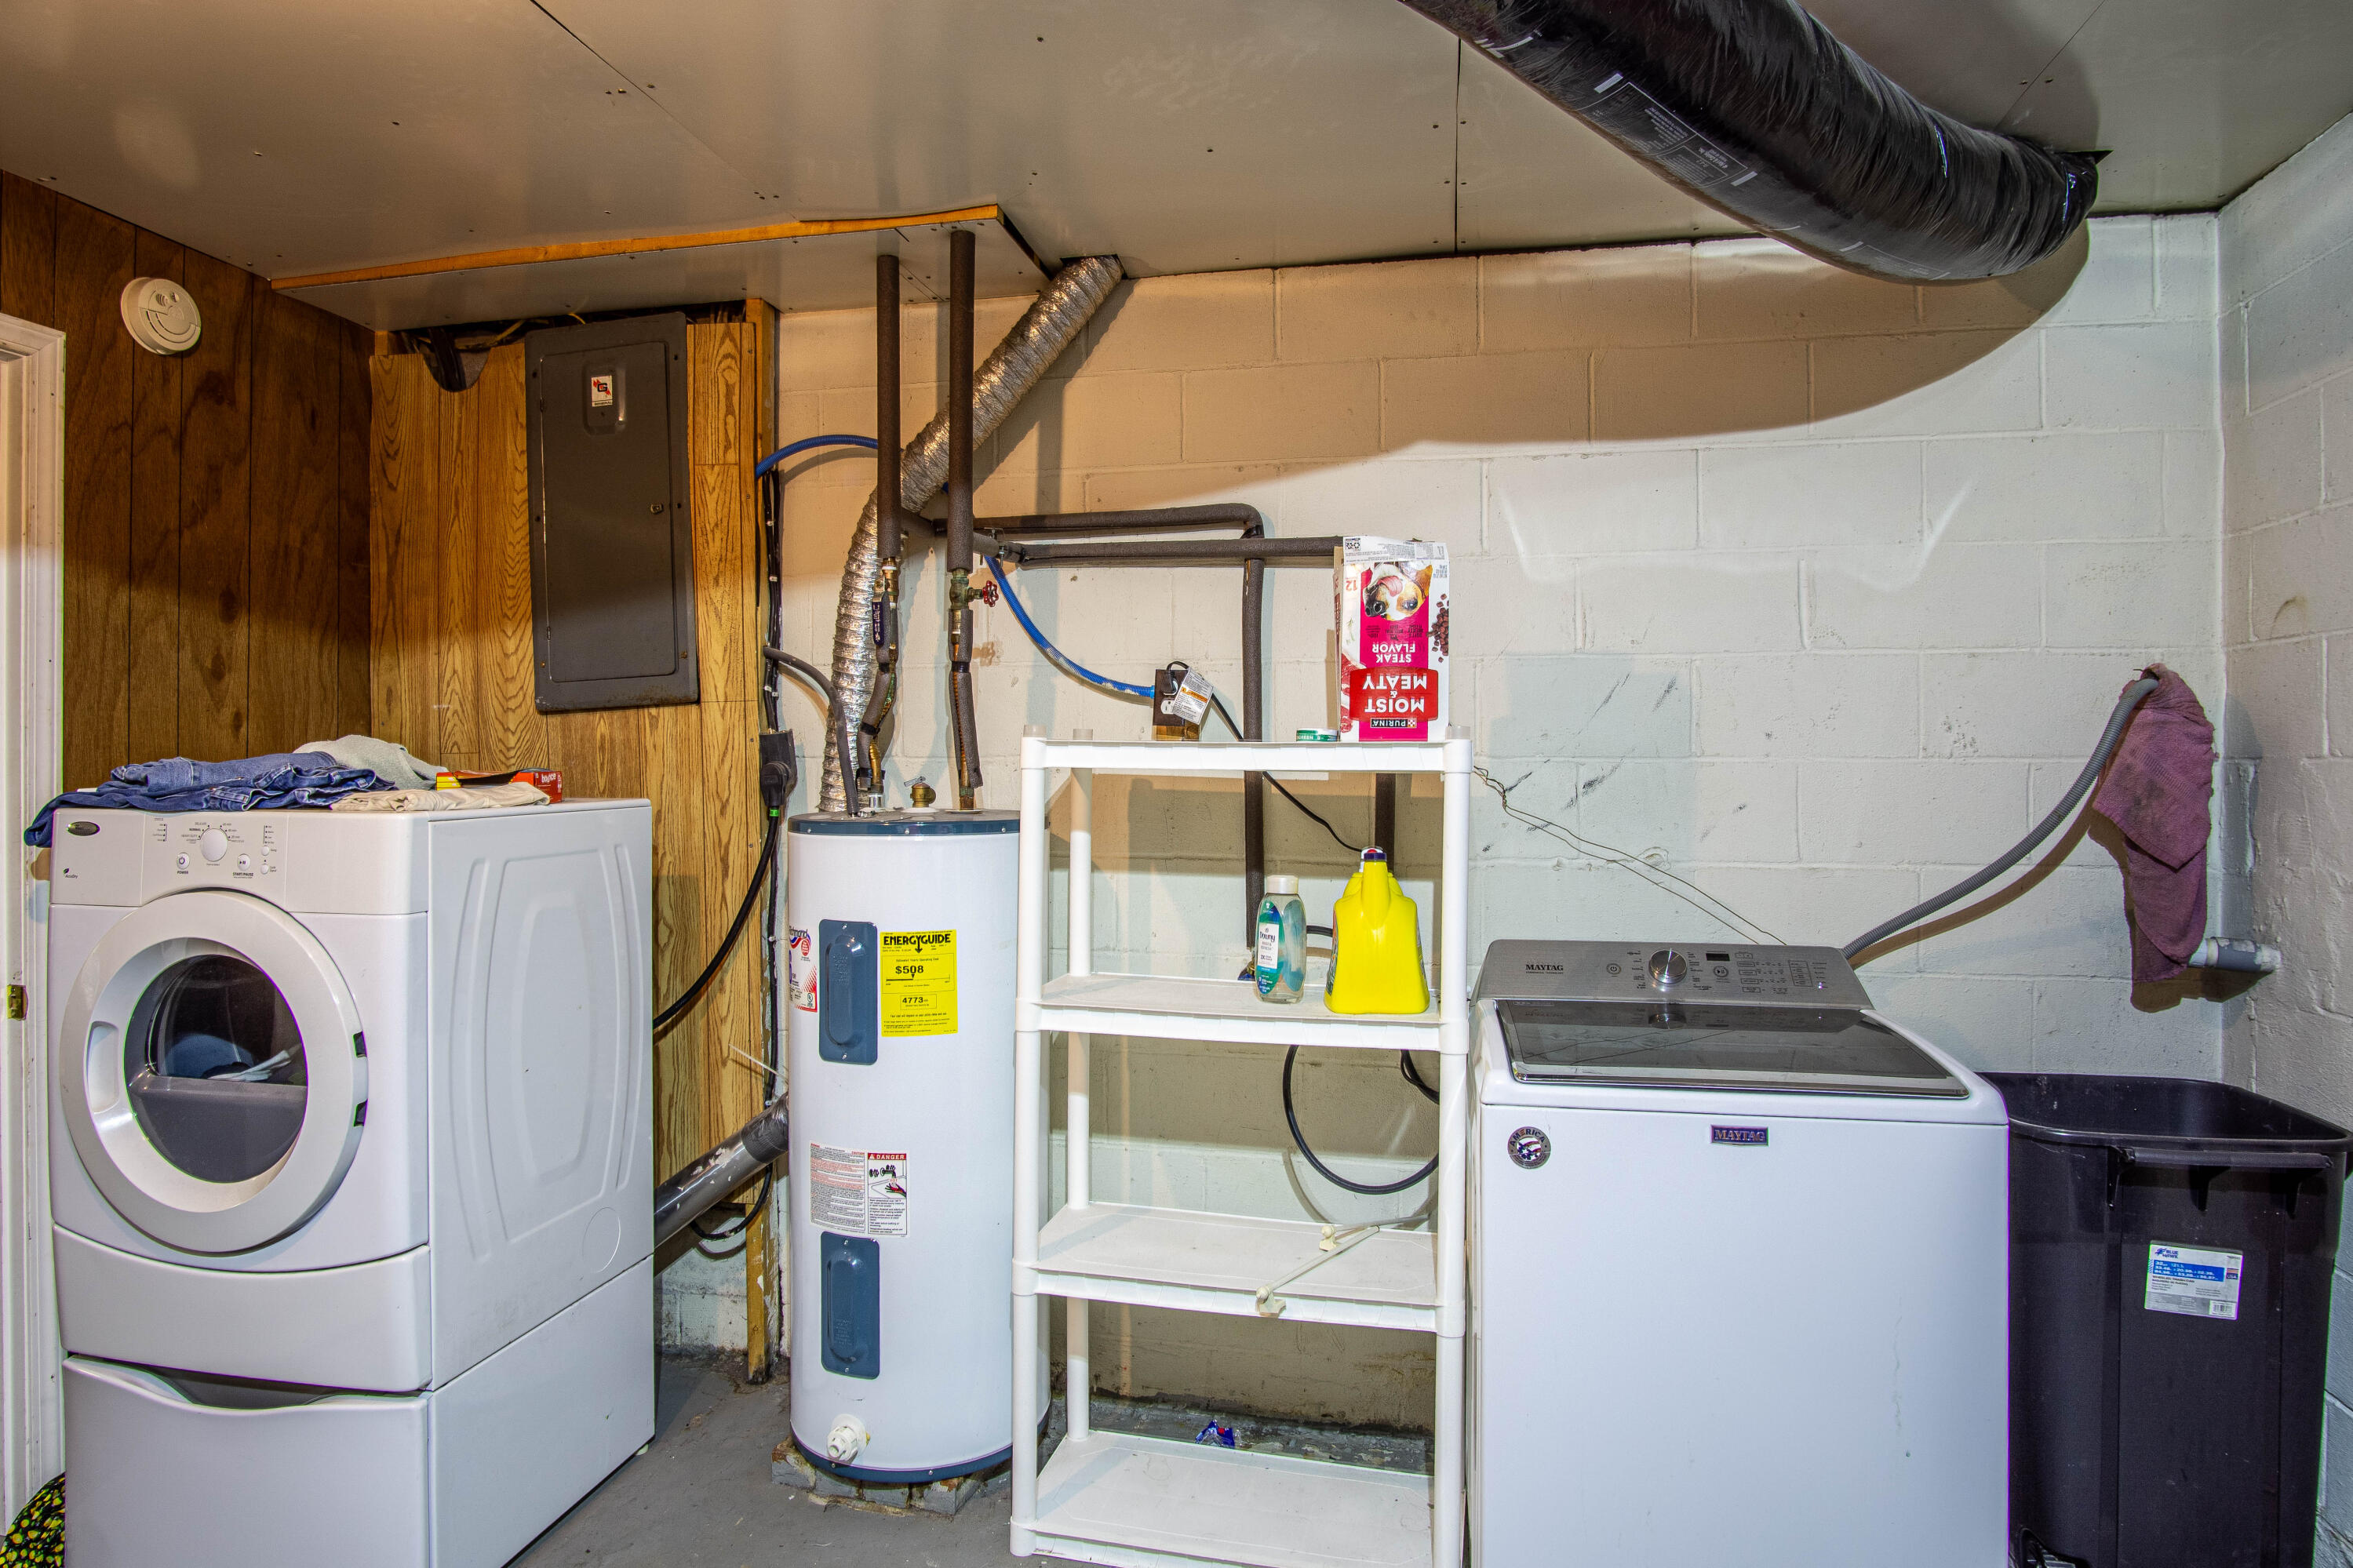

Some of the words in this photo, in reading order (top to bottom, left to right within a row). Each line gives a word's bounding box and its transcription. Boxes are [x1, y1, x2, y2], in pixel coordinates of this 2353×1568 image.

[1346, 580, 1358, 591] 12
[1371, 642, 1416, 653] FLAVOR
[1375, 653, 1412, 664] STEAK
[1362, 674, 1427, 690] MEATY
[1390, 690, 1398, 699] &
[1364, 697, 1425, 713] MOIST
[883, 933, 951, 946] ENERGYGUIDE
[1260, 931, 1276, 943] Downy
[895, 965, 924, 975] $508
[1510, 1128, 1545, 1147] AMERICA
[1714, 1130, 1765, 1141] MAYTAG
